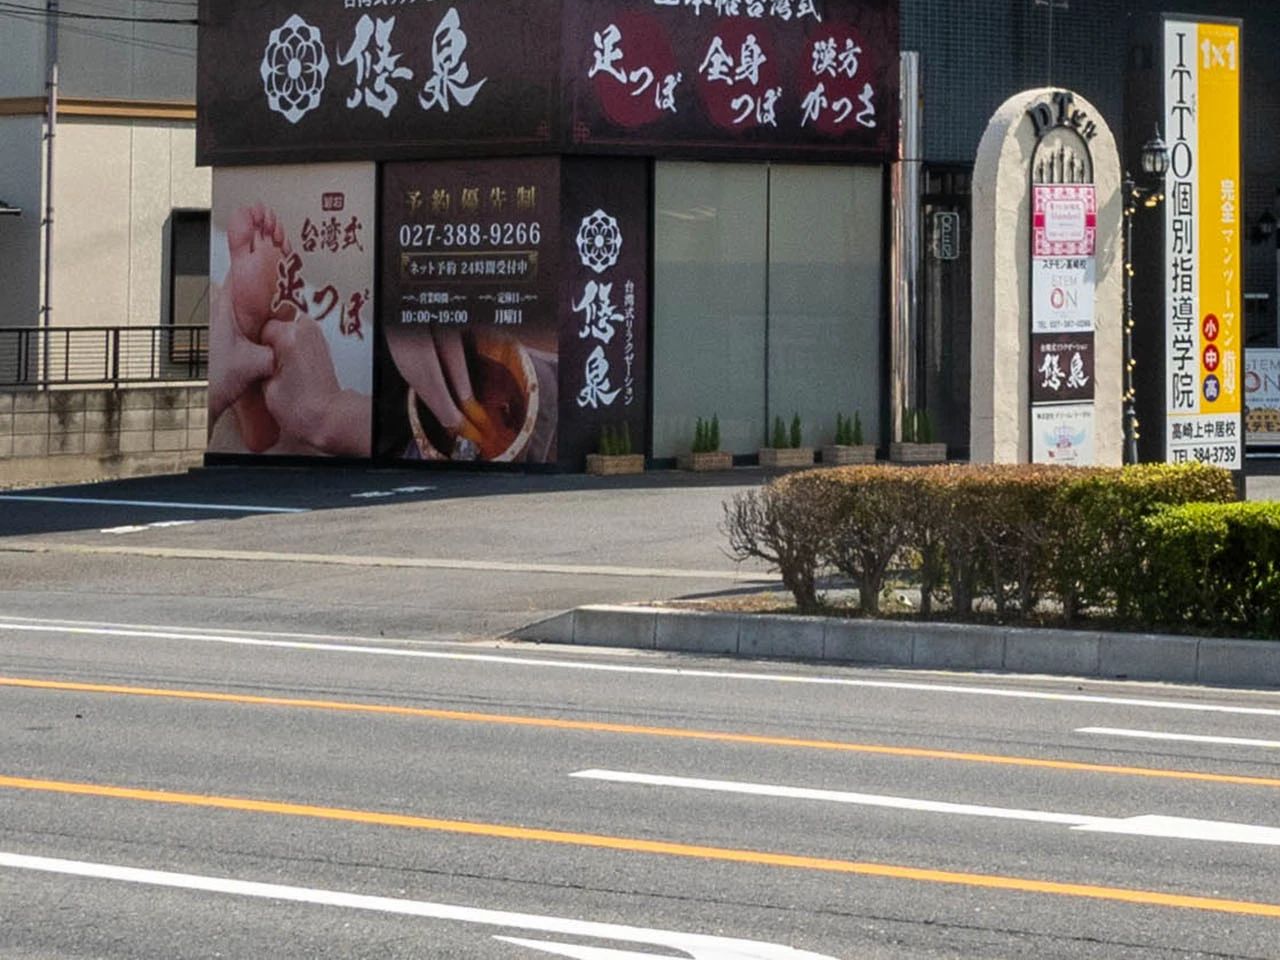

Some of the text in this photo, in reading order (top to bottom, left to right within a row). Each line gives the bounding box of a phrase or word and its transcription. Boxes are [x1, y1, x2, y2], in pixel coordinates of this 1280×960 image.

[301, 216, 364, 253] 台湾式
[399, 222, 541, 246] 027-388-9266
[1172, 421, 1236, 440] 高崎上中居校
